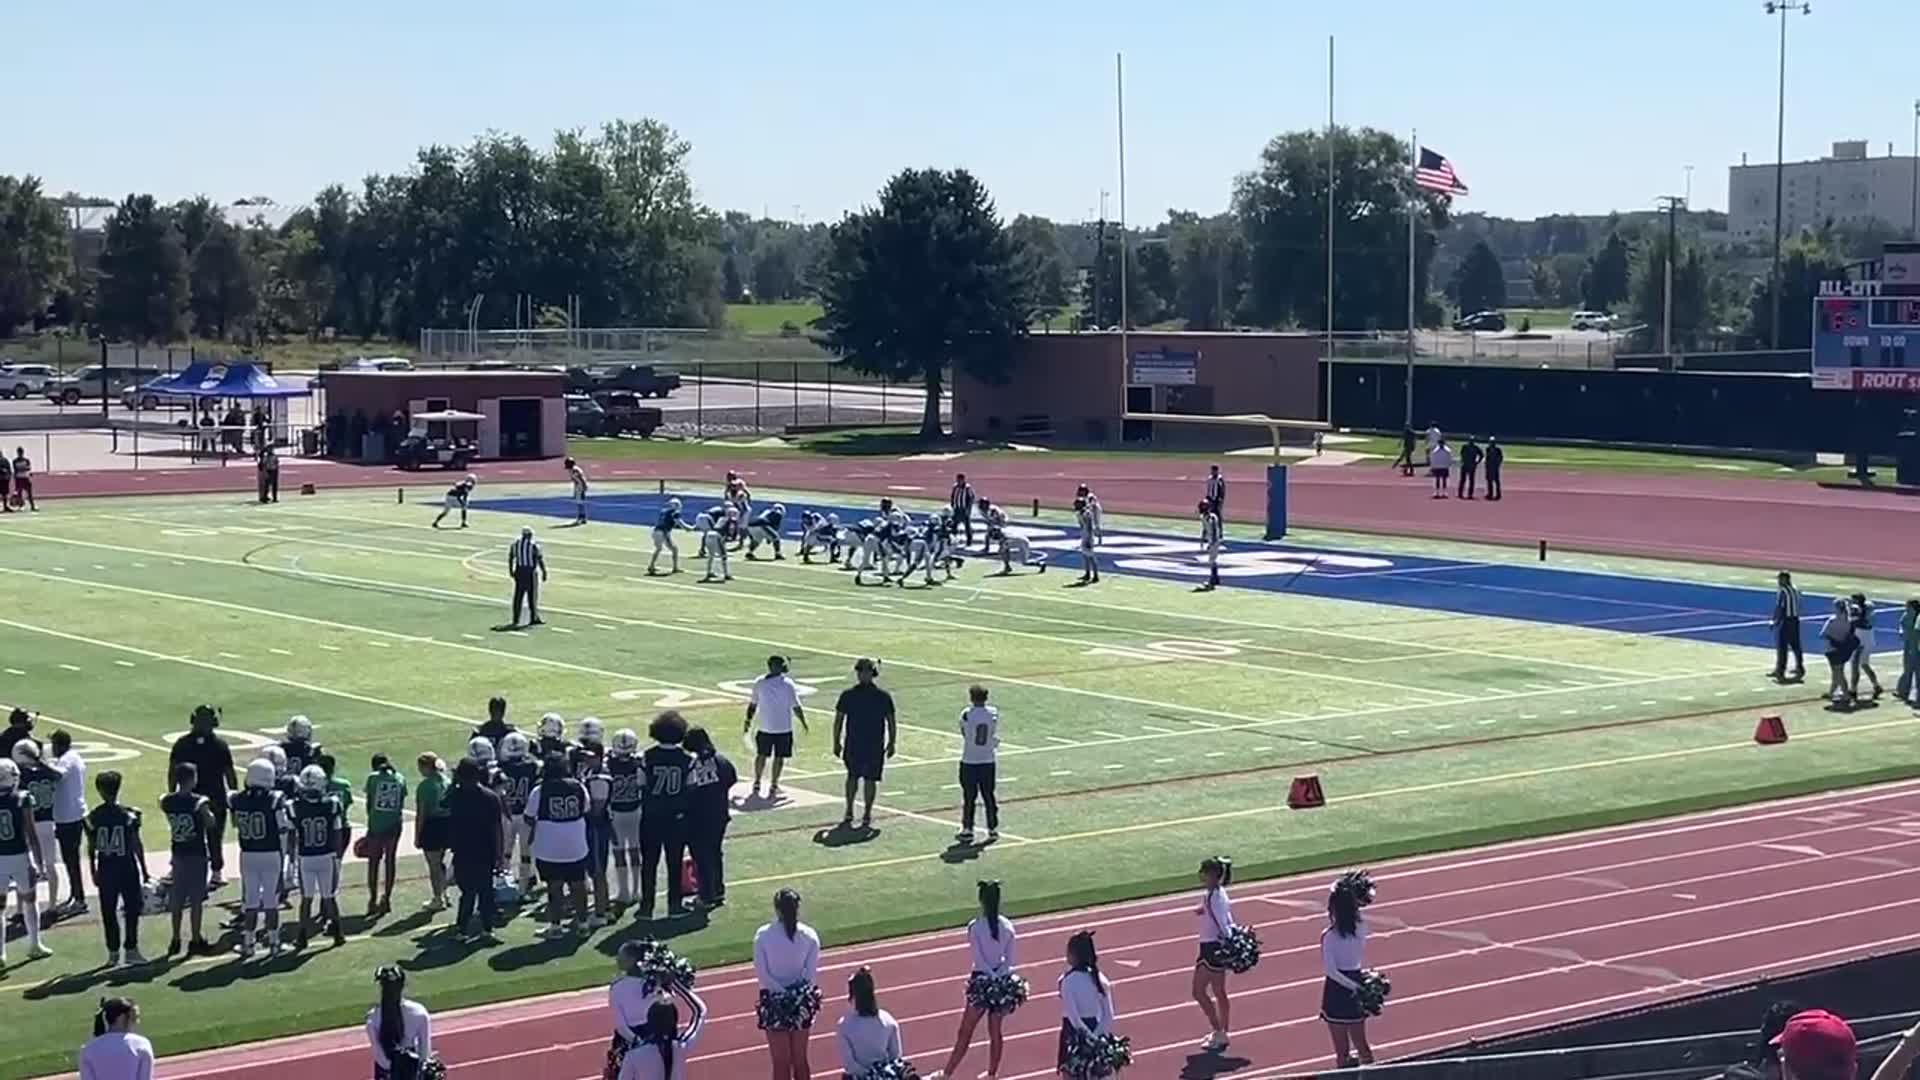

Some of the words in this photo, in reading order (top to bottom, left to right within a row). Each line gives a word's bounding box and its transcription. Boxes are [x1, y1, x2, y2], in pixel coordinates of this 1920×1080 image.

[1819, 280, 1882, 296] ALL-CITY
[1843, 336, 1869, 346] DOWN
[1880, 336, 1891, 346] TO
[1893, 336, 1906, 346] GO
[1862, 373, 1907, 388] ROOT
[975, 723, 988, 746] 0
[652, 765, 682, 796] 70
[237, 811, 267, 840] 50
[97, 825, 126, 856] 44
